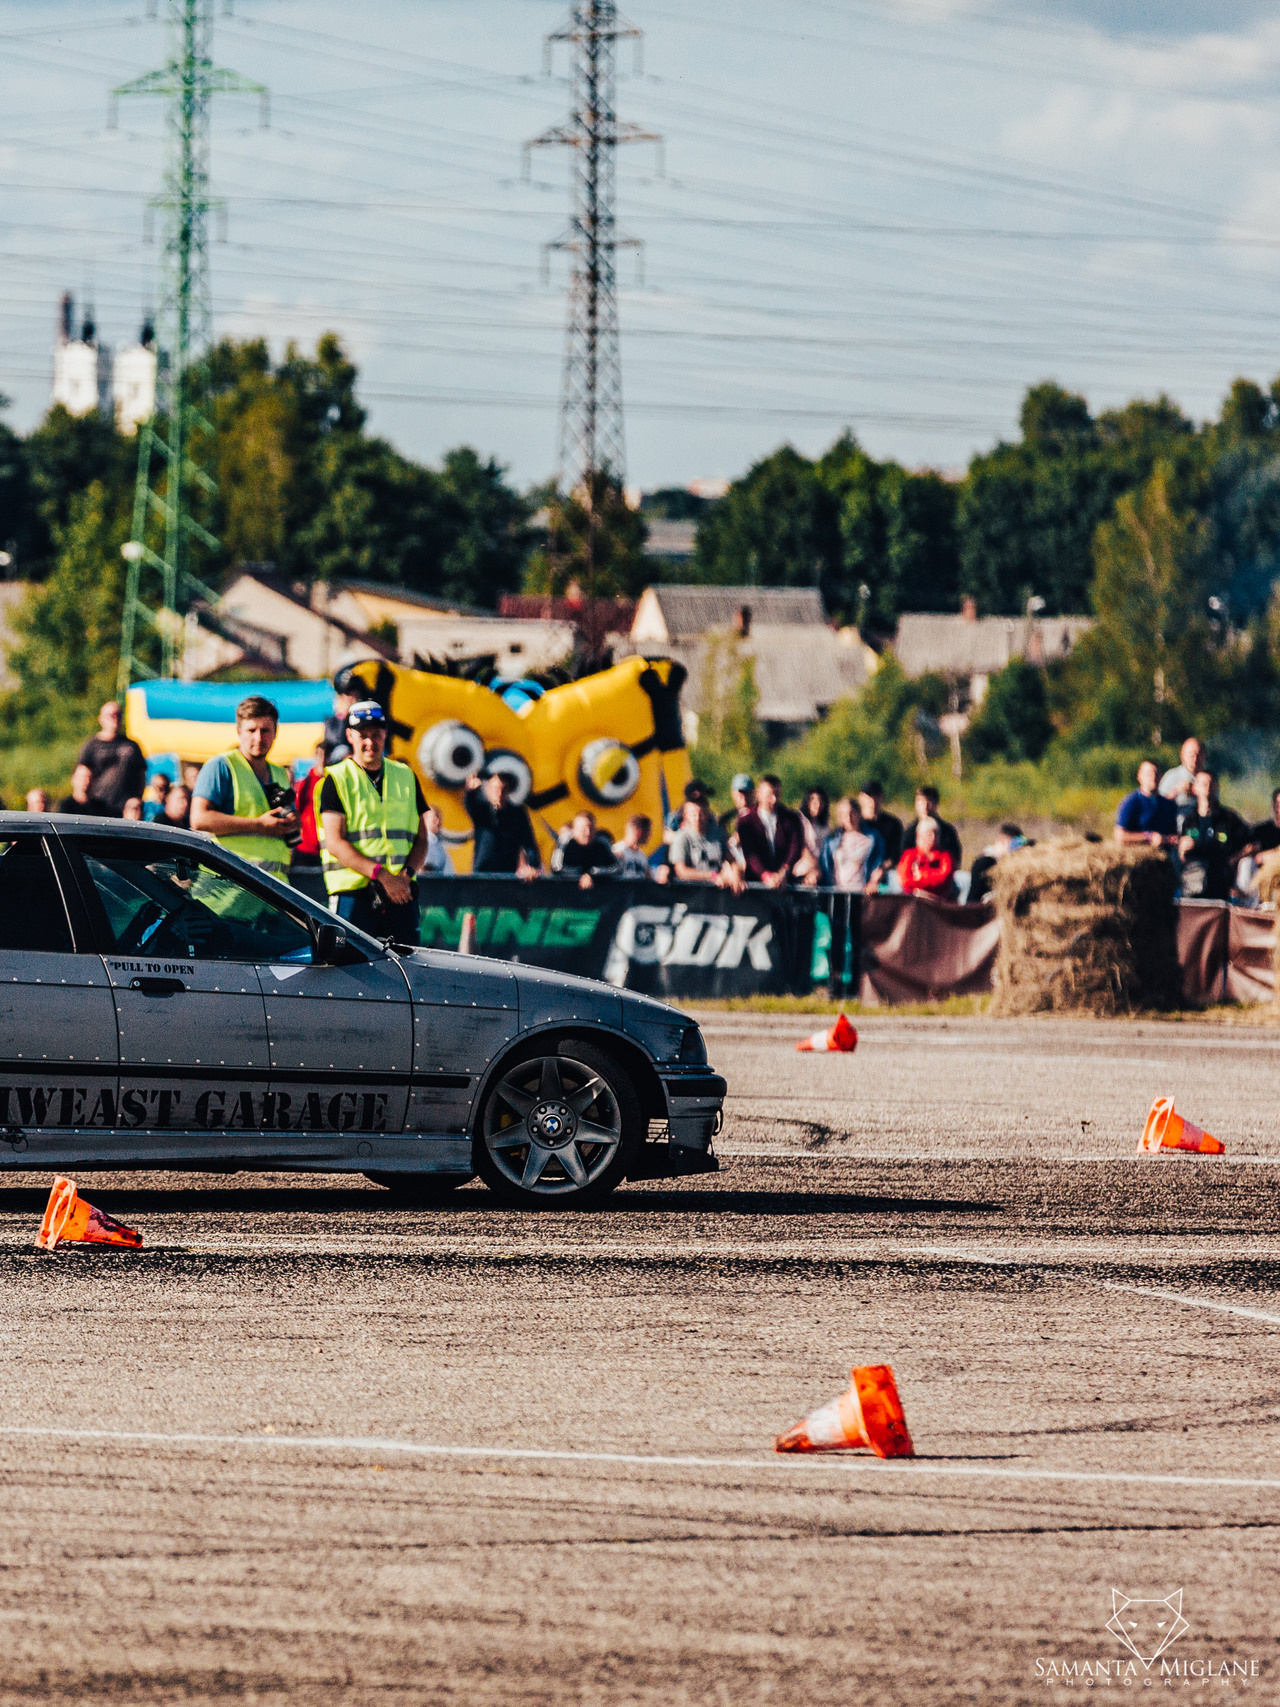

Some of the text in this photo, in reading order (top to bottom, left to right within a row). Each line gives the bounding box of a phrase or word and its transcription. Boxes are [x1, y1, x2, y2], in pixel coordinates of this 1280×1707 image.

[113, 961, 195, 975] PULL TO OPEN
[194, 1090, 389, 1132] GARAGE
